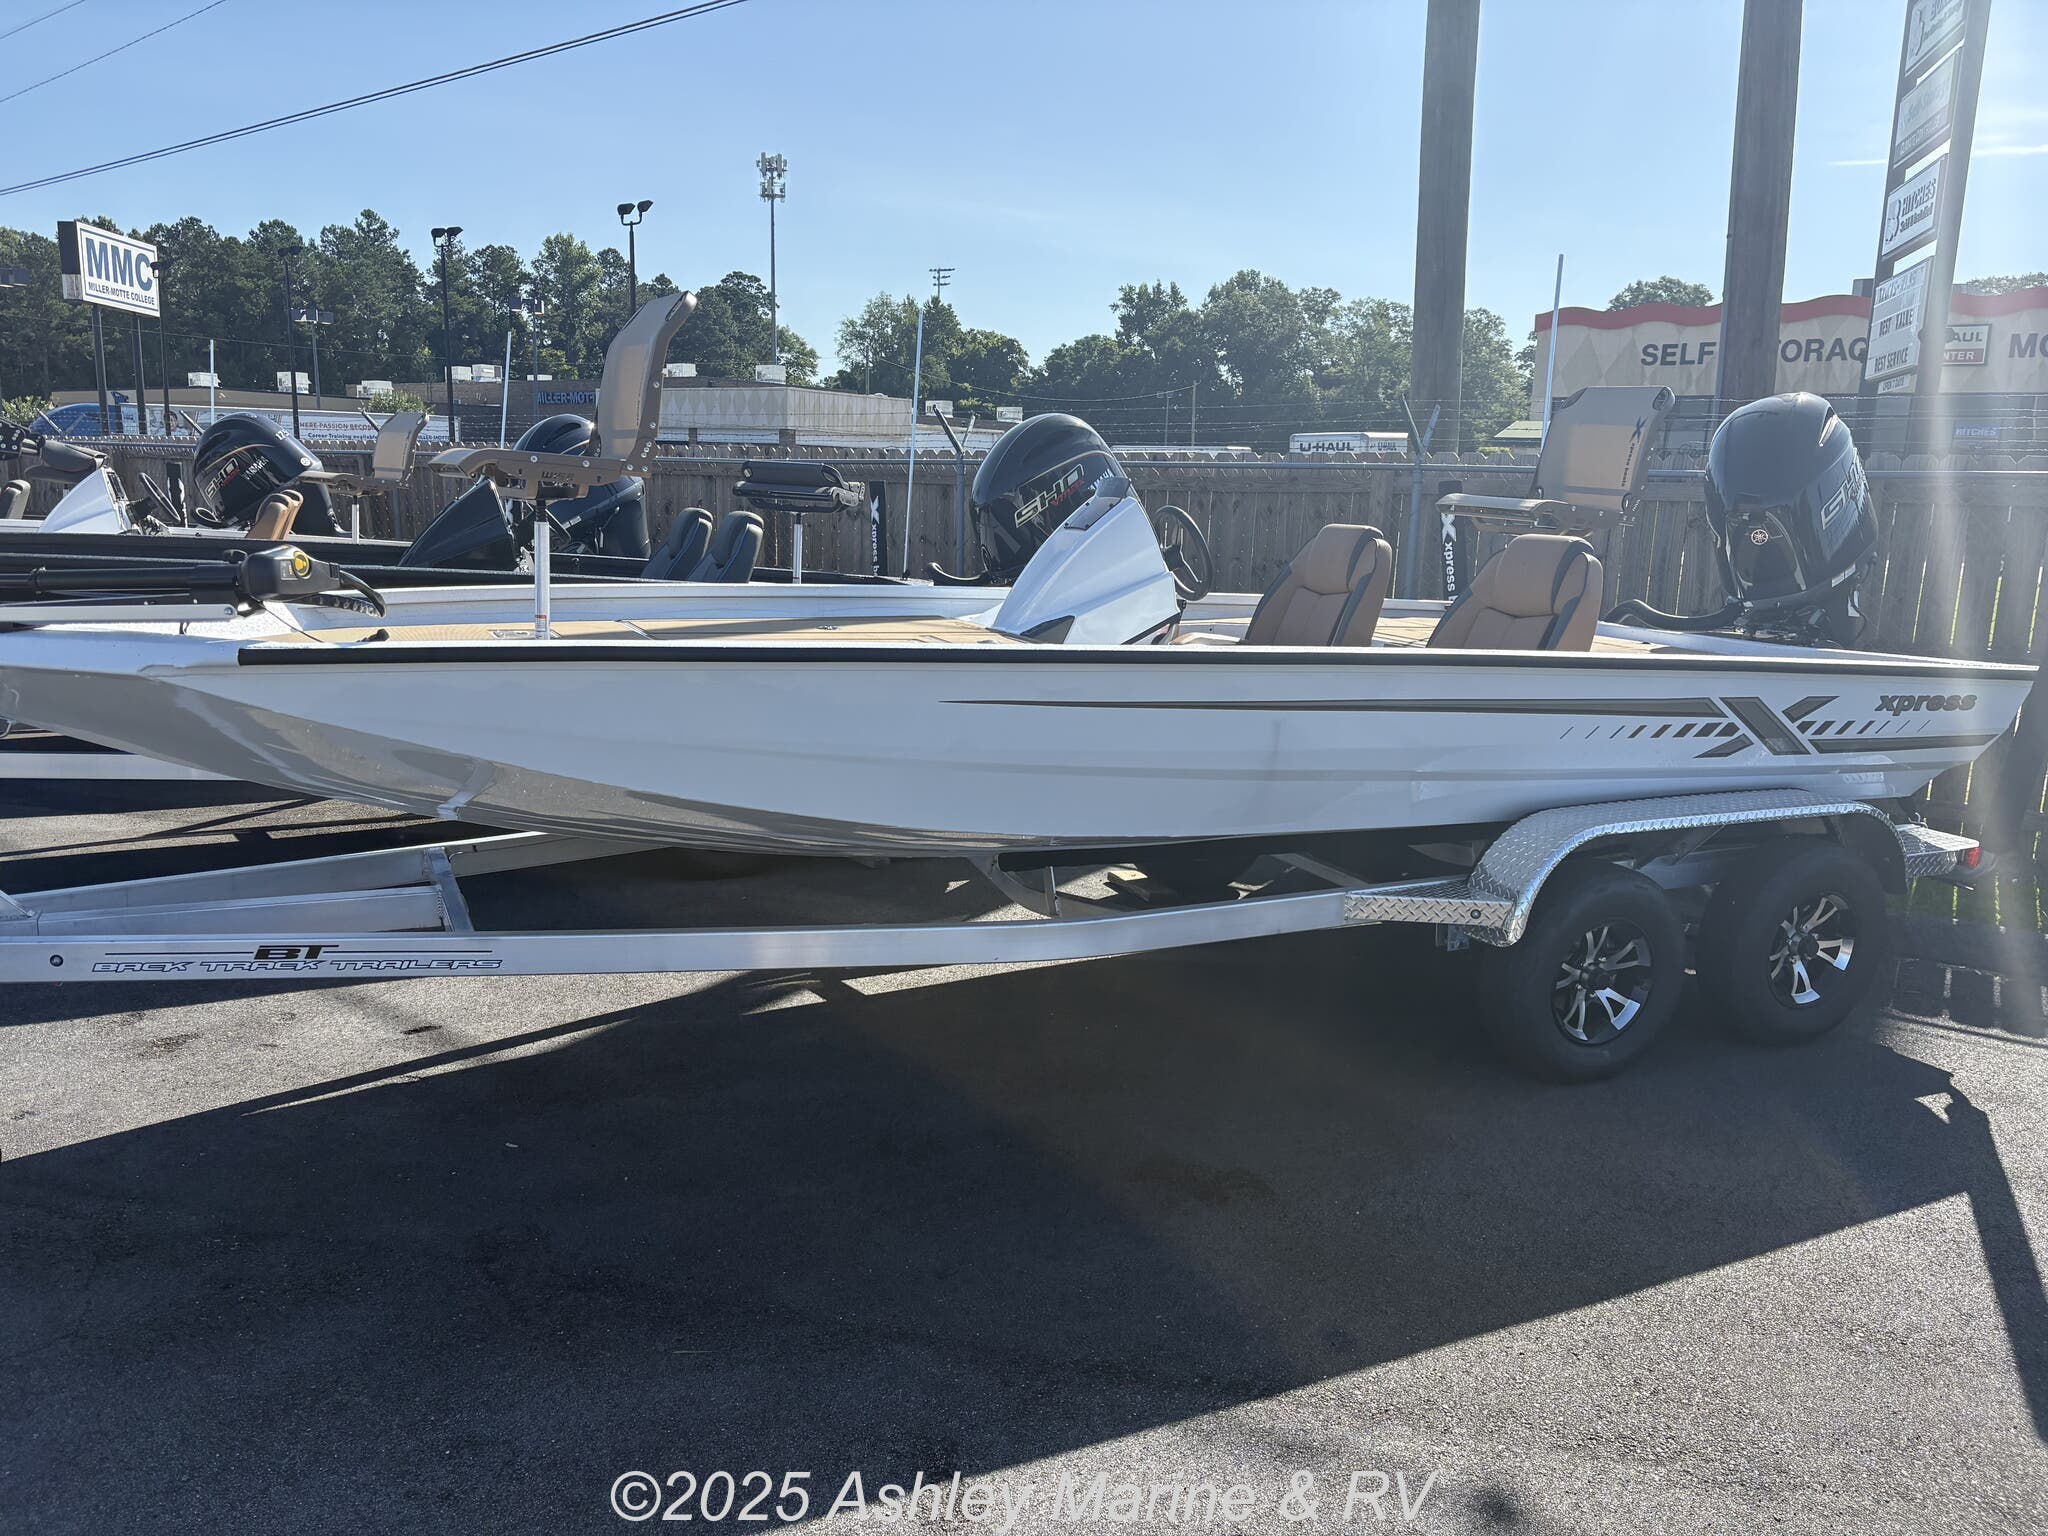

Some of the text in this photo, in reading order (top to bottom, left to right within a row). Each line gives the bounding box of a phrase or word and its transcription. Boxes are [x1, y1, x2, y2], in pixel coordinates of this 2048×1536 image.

[86, 237, 153, 291] MMC
[88, 281, 155, 306] MILLER-MOTTE COLLEGE
[1640, 336, 1868, 367] SELF ORAG
[1943, 350, 1975, 360] NTER
[275, 428, 291, 441] 175
[1955, 427, 1997, 437] HITCHES
[1300, 441, 1355, 452] U-HAUL
[204, 457, 239, 500] SHO
[1014, 463, 1085, 528] SHO
[1443, 541, 1456, 592] xpress
[1874, 694, 1978, 717] xpress
[254, 945, 339, 960] BT
[91, 959, 503, 974] BACK TRACK TRAILERS
